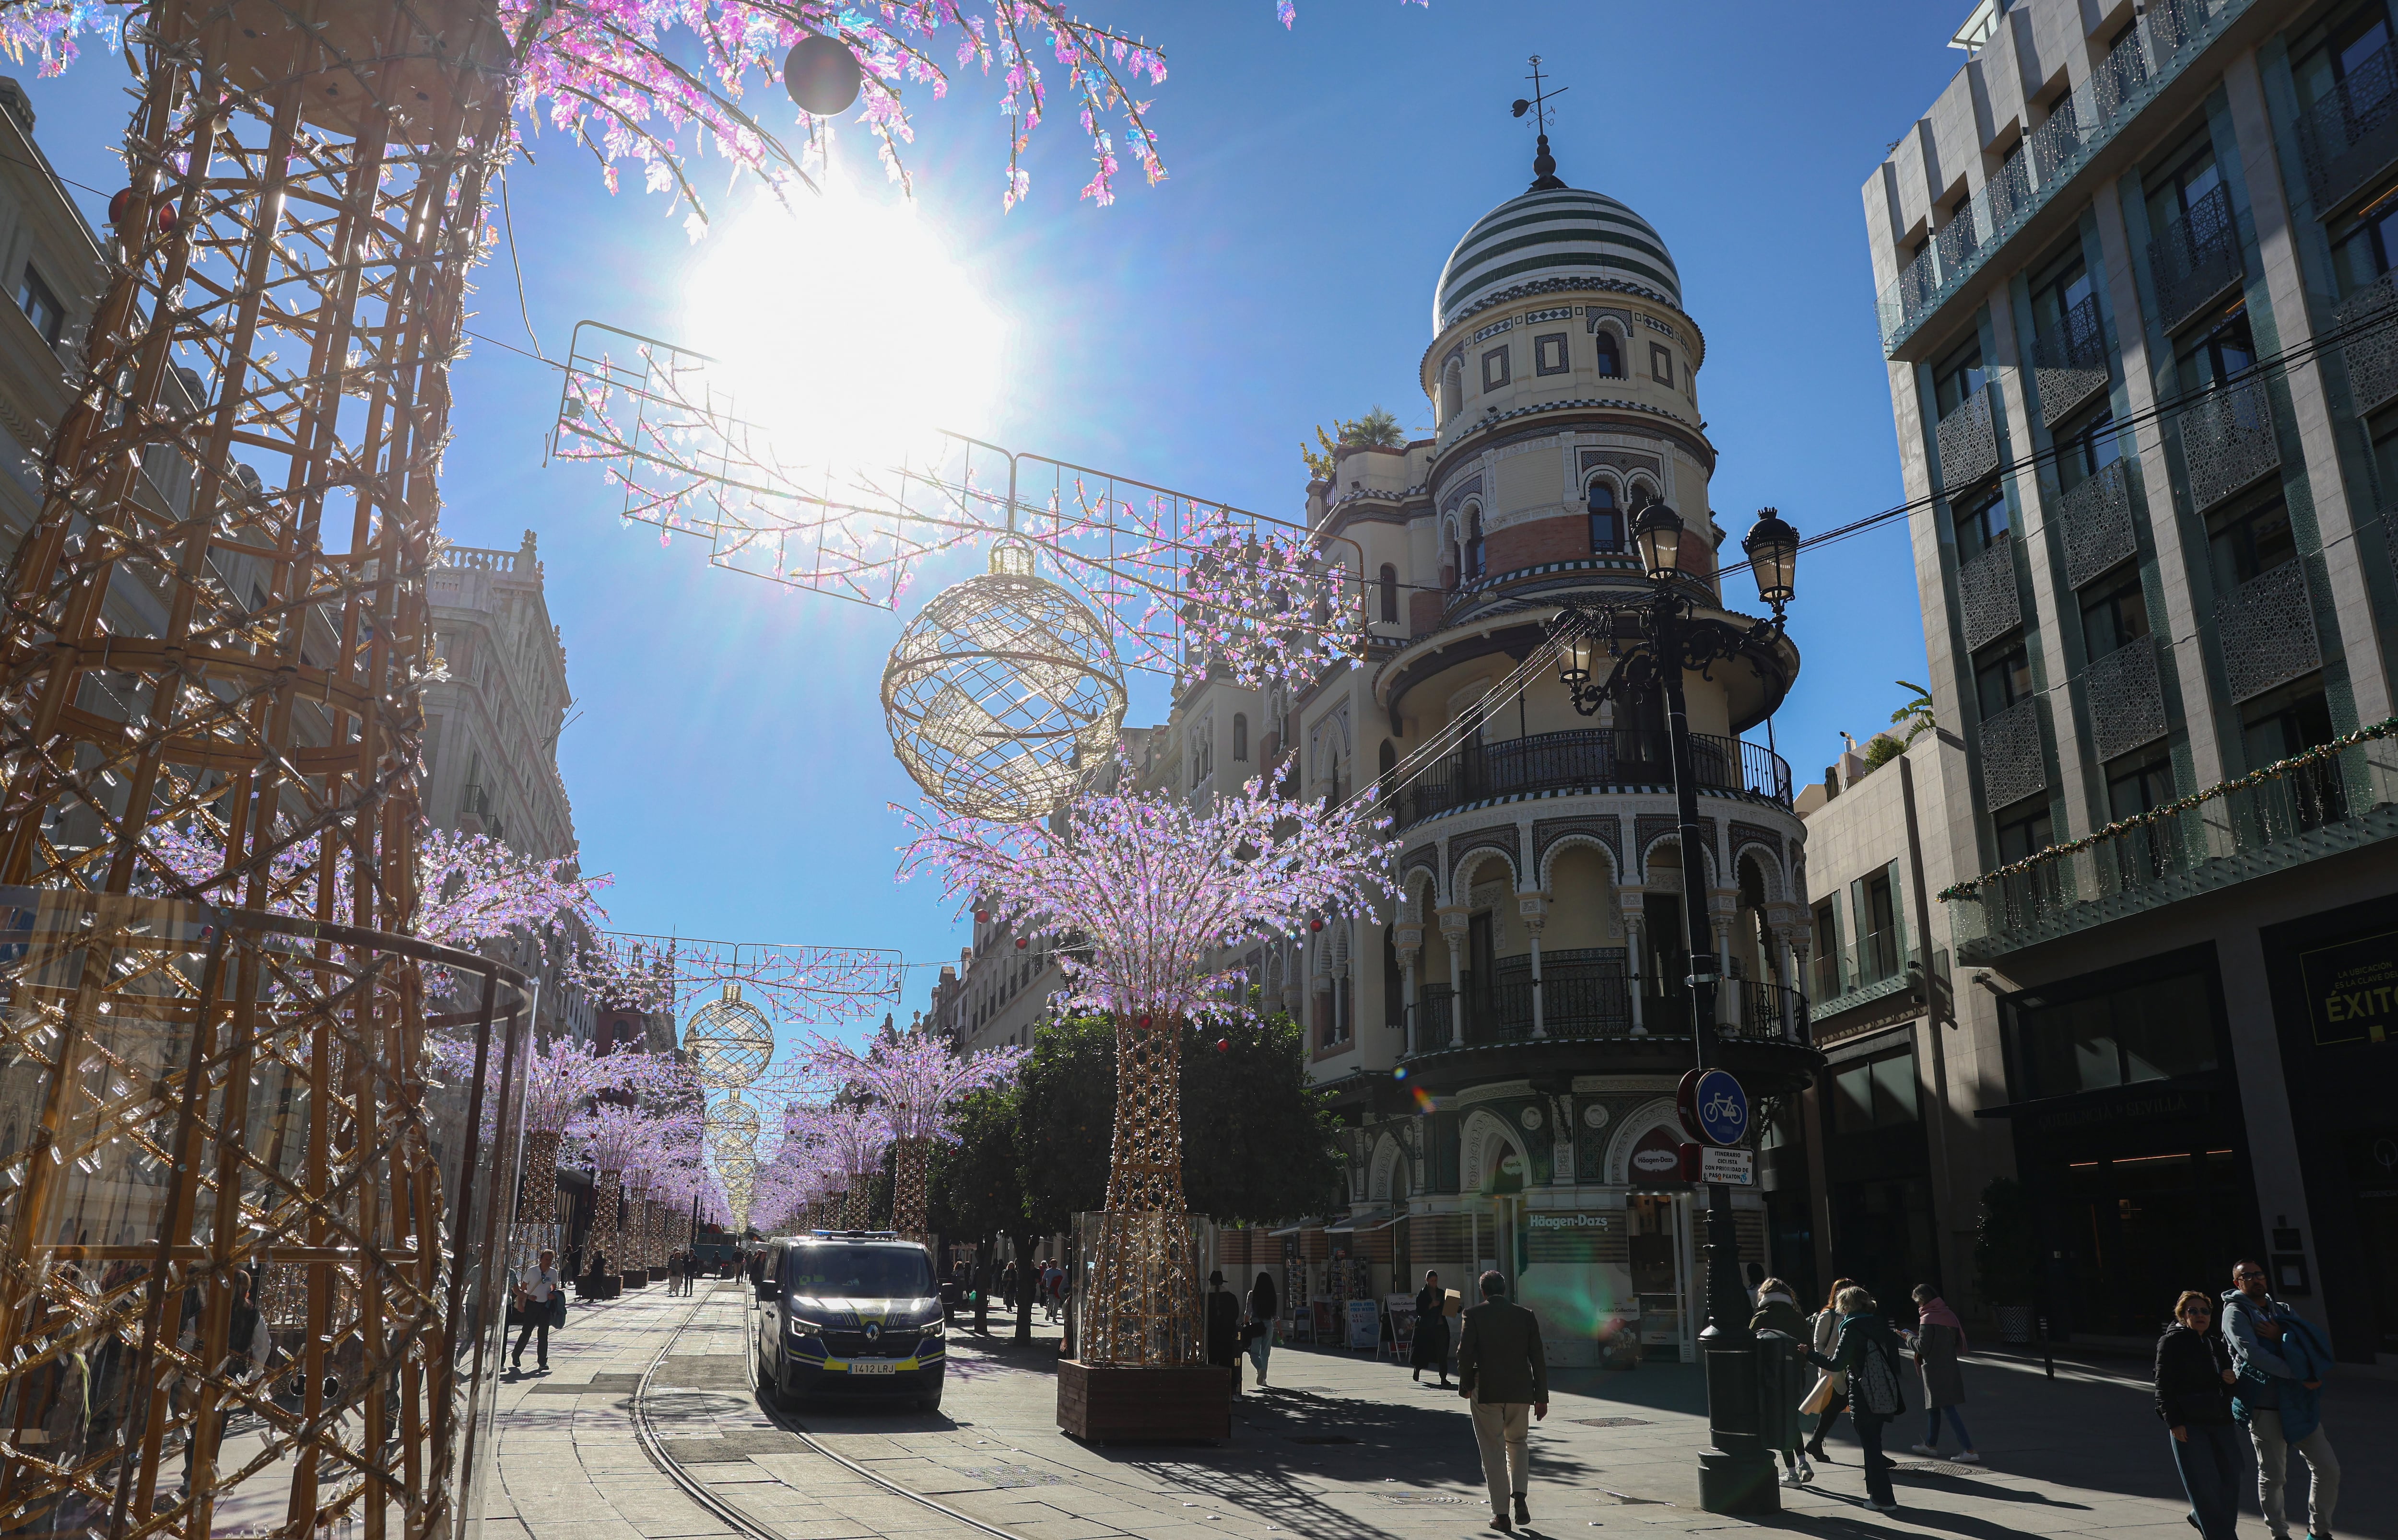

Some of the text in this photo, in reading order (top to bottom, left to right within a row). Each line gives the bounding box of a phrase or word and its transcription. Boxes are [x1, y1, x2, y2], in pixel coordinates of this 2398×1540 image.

[2346, 979, 2356, 987] LA
[2357, 974, 2383, 984] CLAVE
[2325, 986, 2398, 1023] ÉXIT
[1530, 1214, 1608, 1230] Häagen-Dazs
